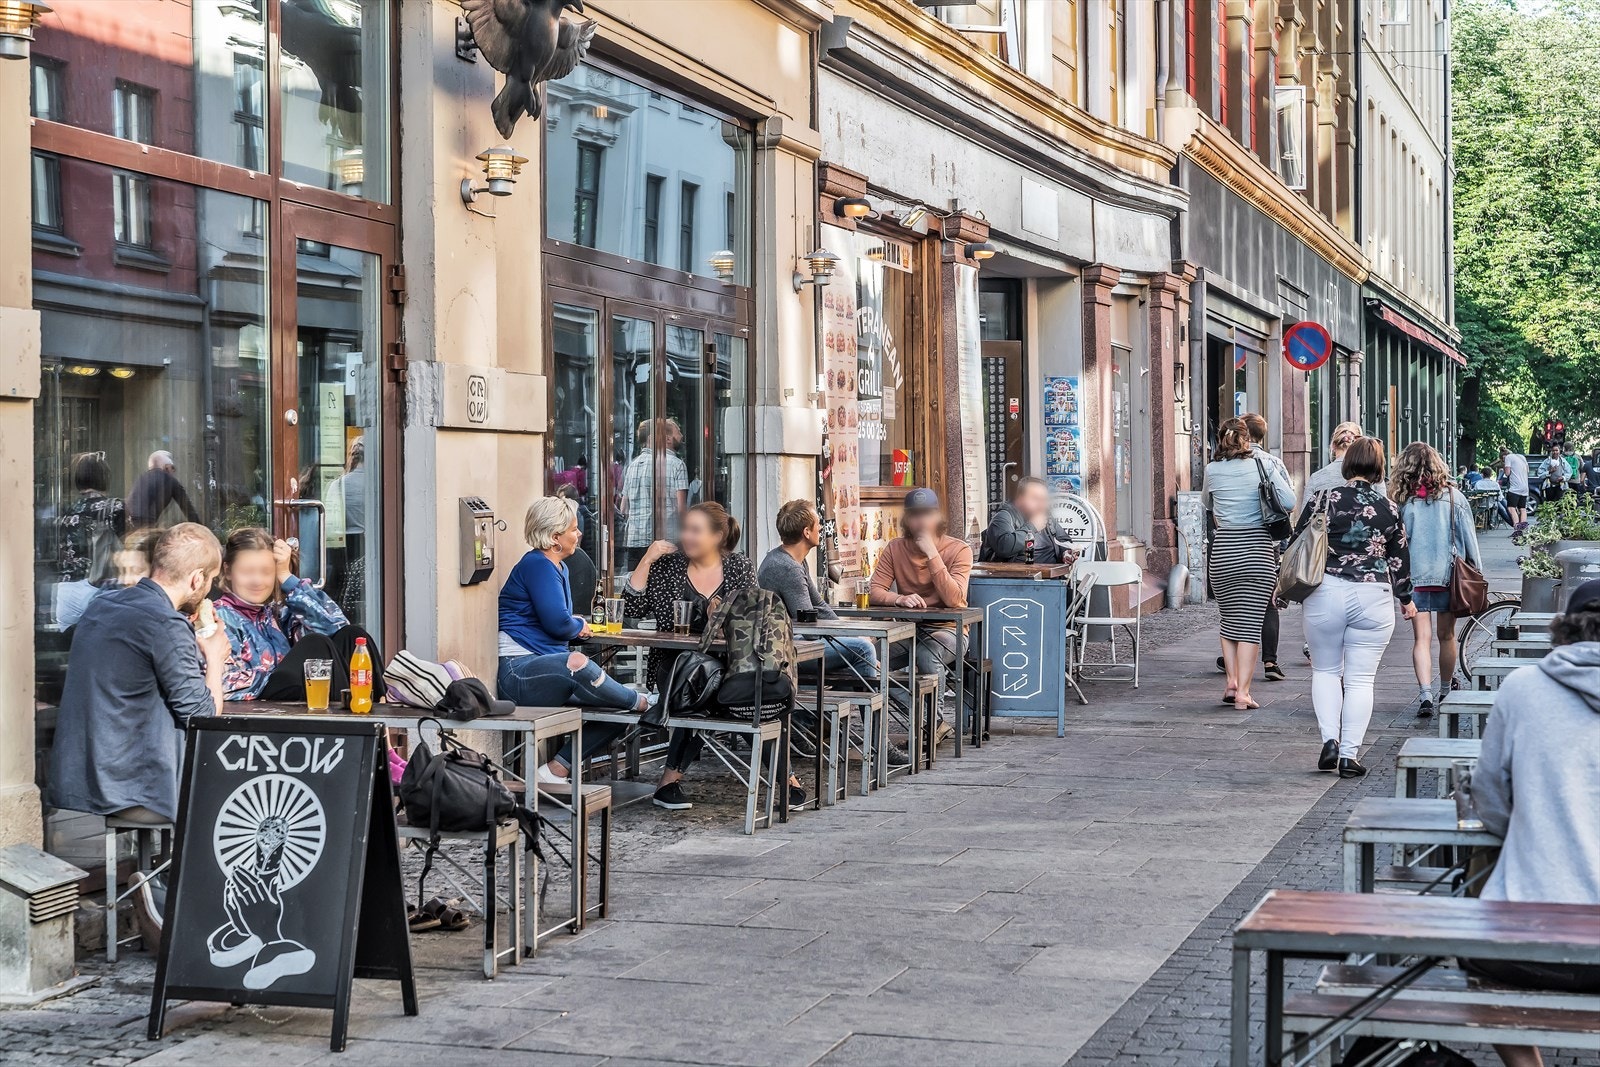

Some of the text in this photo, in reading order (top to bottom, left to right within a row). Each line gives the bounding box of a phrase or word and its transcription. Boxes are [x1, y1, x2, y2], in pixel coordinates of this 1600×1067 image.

[857, 306, 904, 390] TERANEAN
[858, 368, 882, 396] GRILL
[894, 461, 903, 474] JUST
[1052, 502, 1089, 525] erranean
[216, 735, 345, 774] CROW
